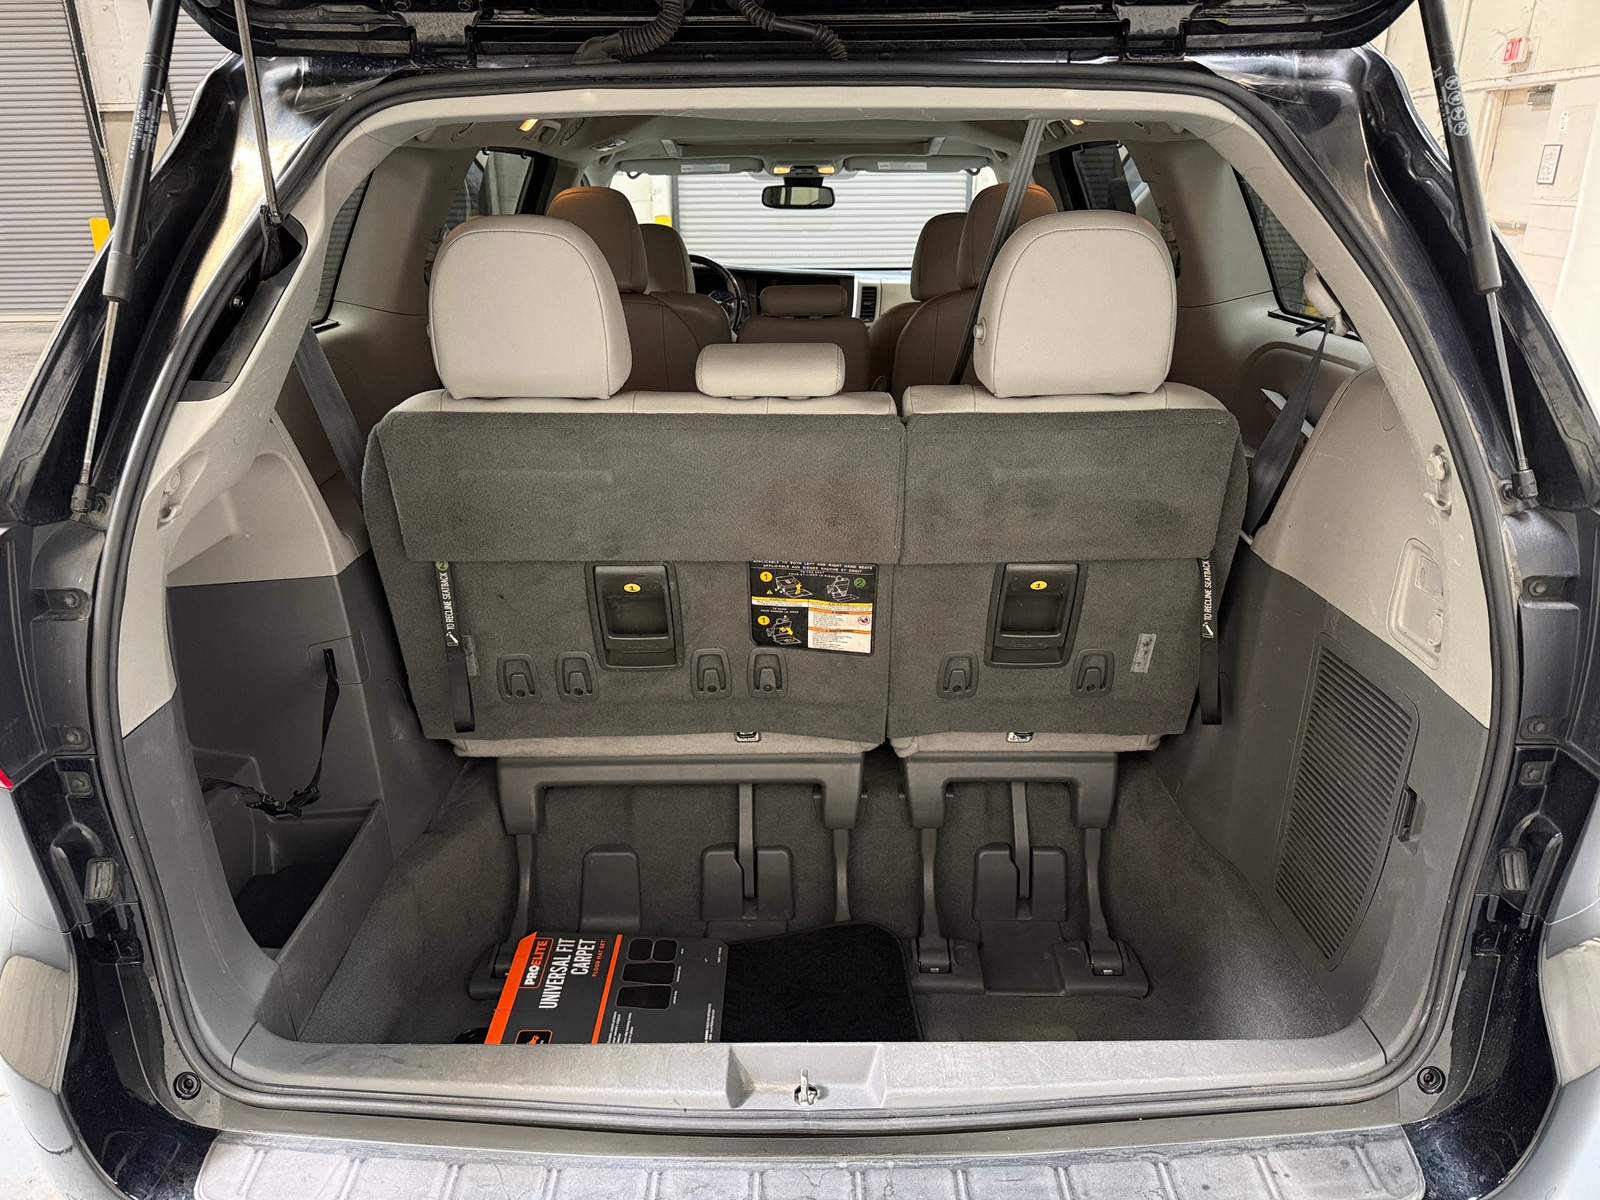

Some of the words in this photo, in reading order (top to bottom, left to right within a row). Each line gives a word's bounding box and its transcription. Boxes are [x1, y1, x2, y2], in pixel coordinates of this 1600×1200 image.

[1503, 38, 1522, 61] EXIT
[440, 572, 451, 600] SEATBACK
[1202, 560, 1212, 588] SEATBACK
[443, 600, 455, 623] RECLINE
[1203, 589, 1212, 613] RECLINE
[446, 623, 455, 631] TO
[524, 940, 548, 985] PROELITE
[570, 938, 596, 975] CARPET
[591, 960, 600, 977] FLOOR
[538, 954, 571, 1009] UNIVERSAL
[555, 937, 576, 952] FIT
